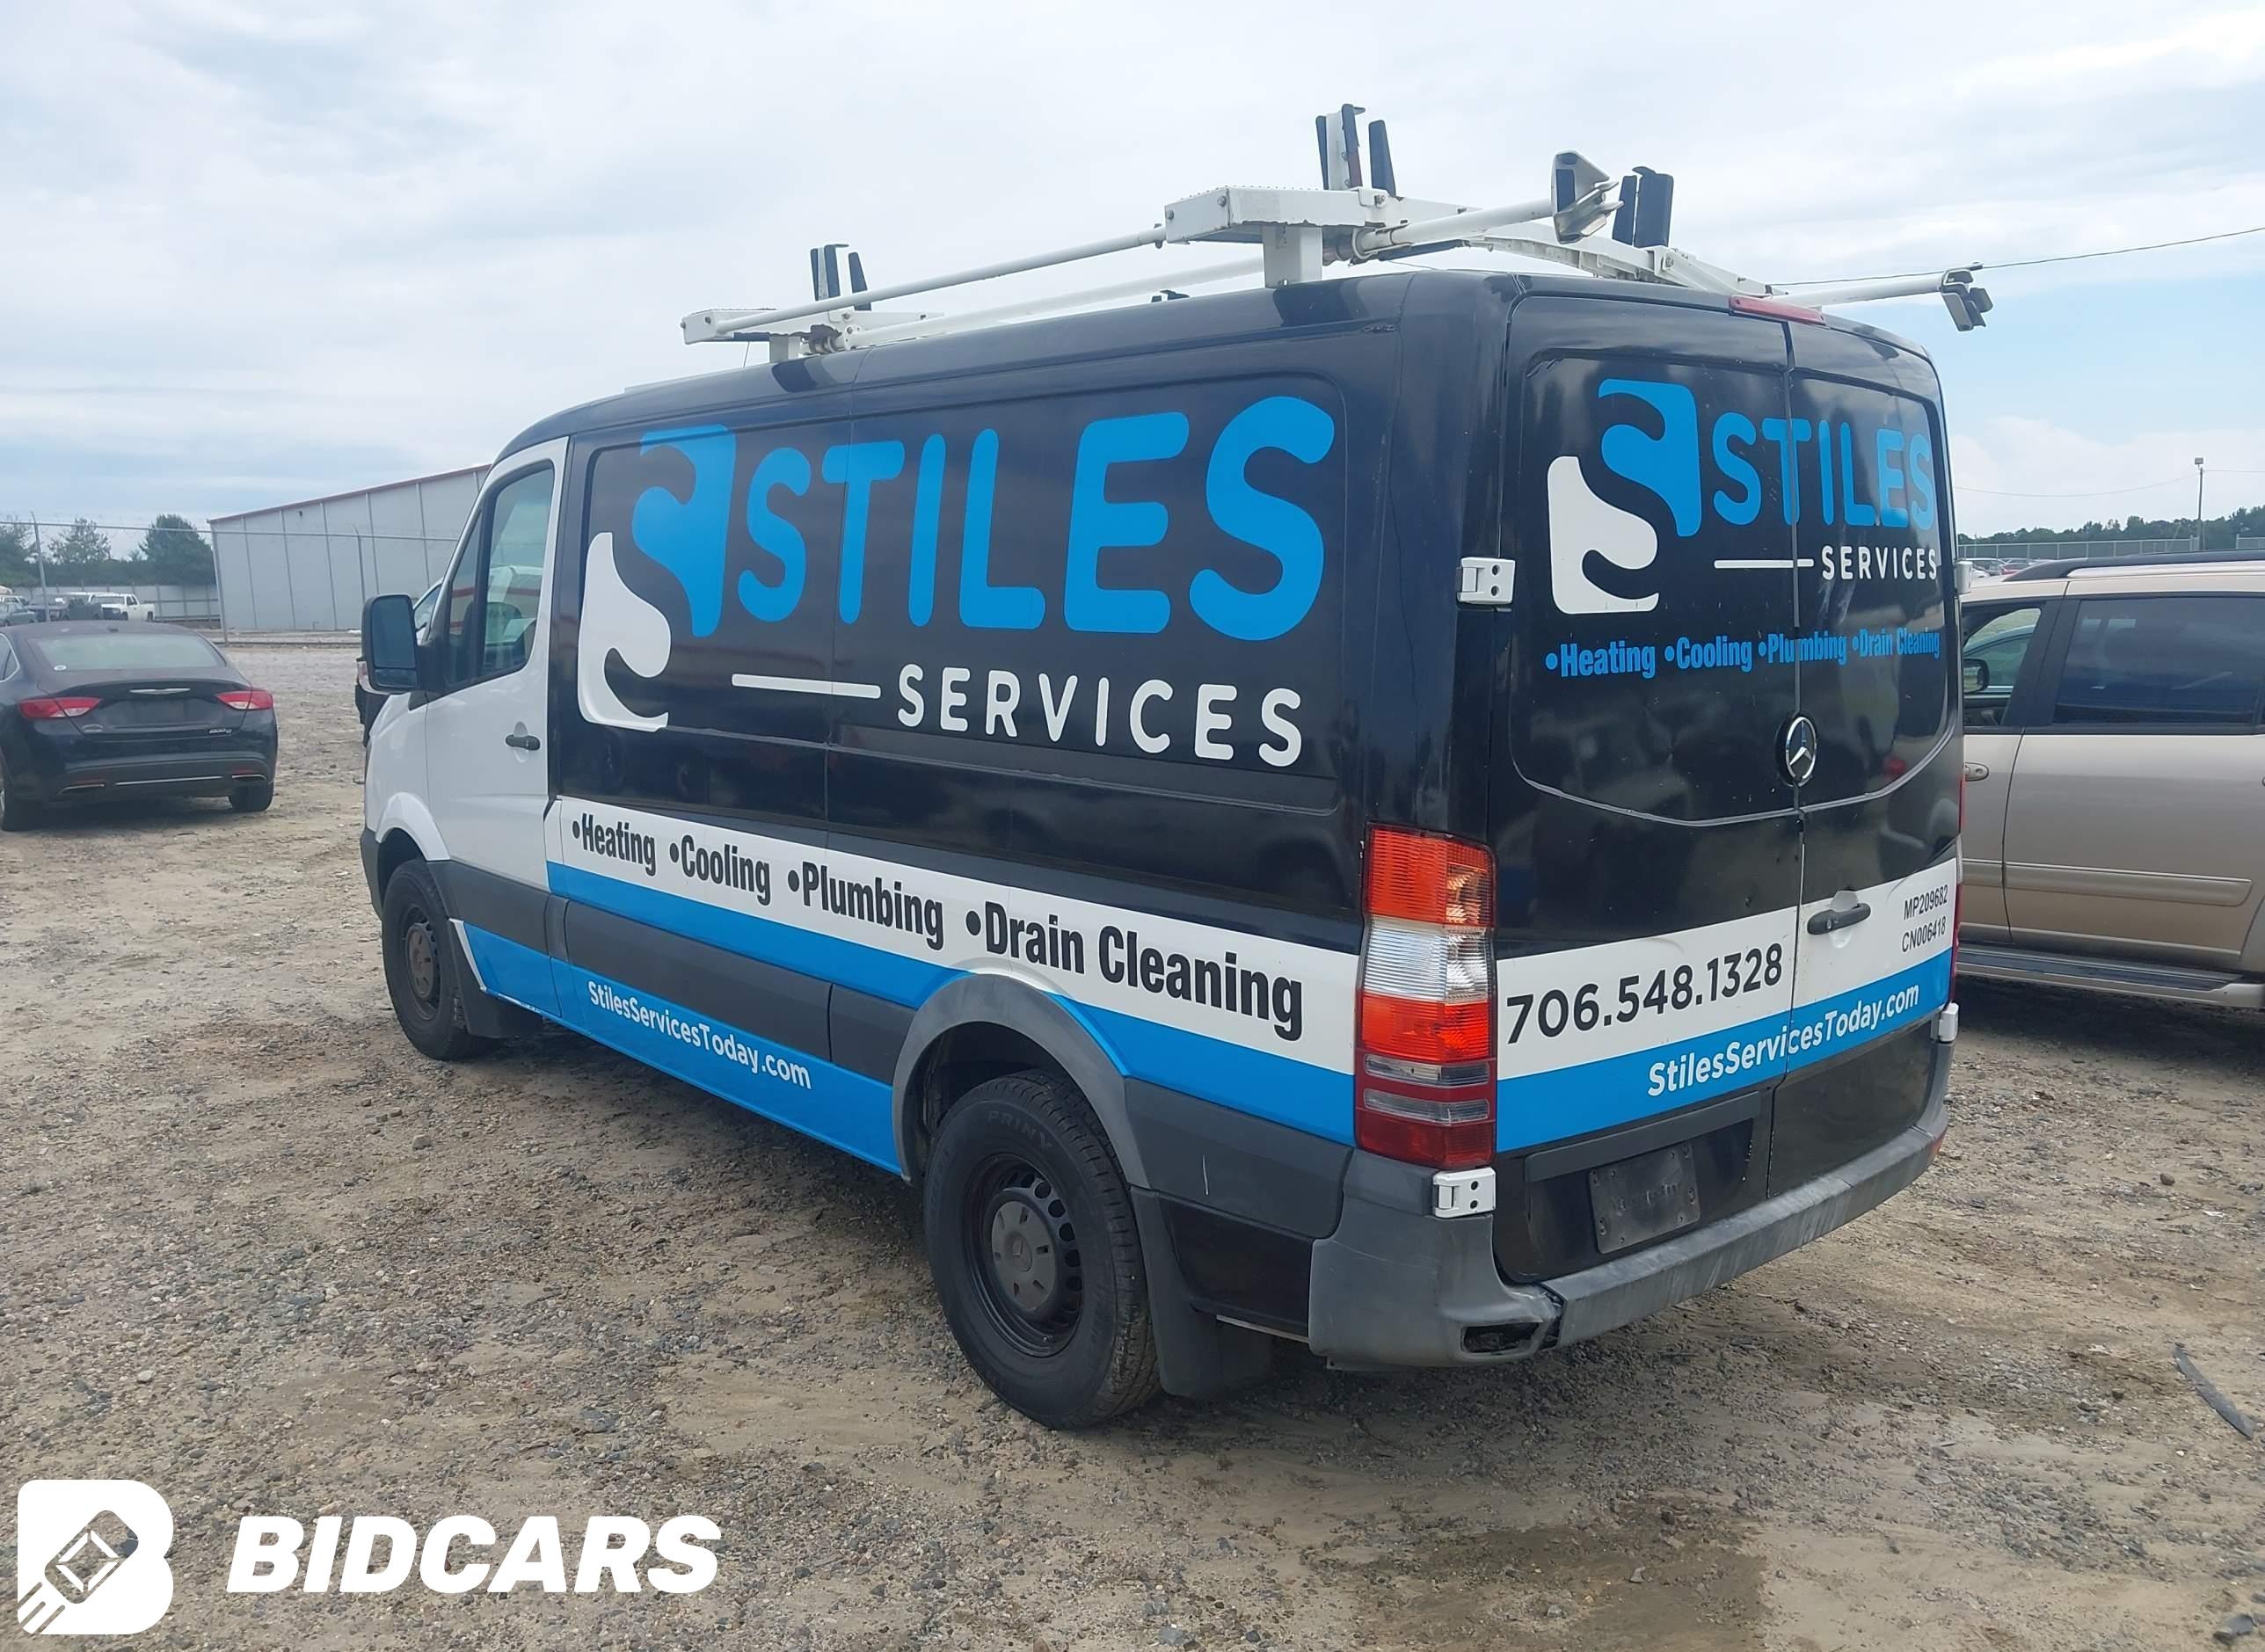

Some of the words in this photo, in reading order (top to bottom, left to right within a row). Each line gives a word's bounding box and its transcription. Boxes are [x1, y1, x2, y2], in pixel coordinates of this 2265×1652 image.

[737, 397, 1335, 641] STILES
[1712, 412, 1934, 531] STILES
[1822, 545, 1937, 580] SERVICES
[1561, 640, 1655, 679] Heating
[1676, 636, 1752, 673] Cooling
[1859, 630, 1893, 656] Drain
[1896, 627, 1941, 659] Cleaning
[898, 664, 1302, 767] SERVICES
[580, 812, 657, 877] Heating
[680, 834, 771, 906] Cooling
[801, 861, 944, 950] Plumbing
[985, 901, 1085, 974] Drain
[1098, 925, 1304, 1041] Cleaning
[1902, 915, 1947, 953] CN006418
[1903, 884, 1948, 921] MP209682
[587, 980, 812, 1090] StilesServicesToday.com
[1506, 942, 1783, 1044] 706.548.1328
[1647, 982, 1920, 1097] StilesServicesToday.com
